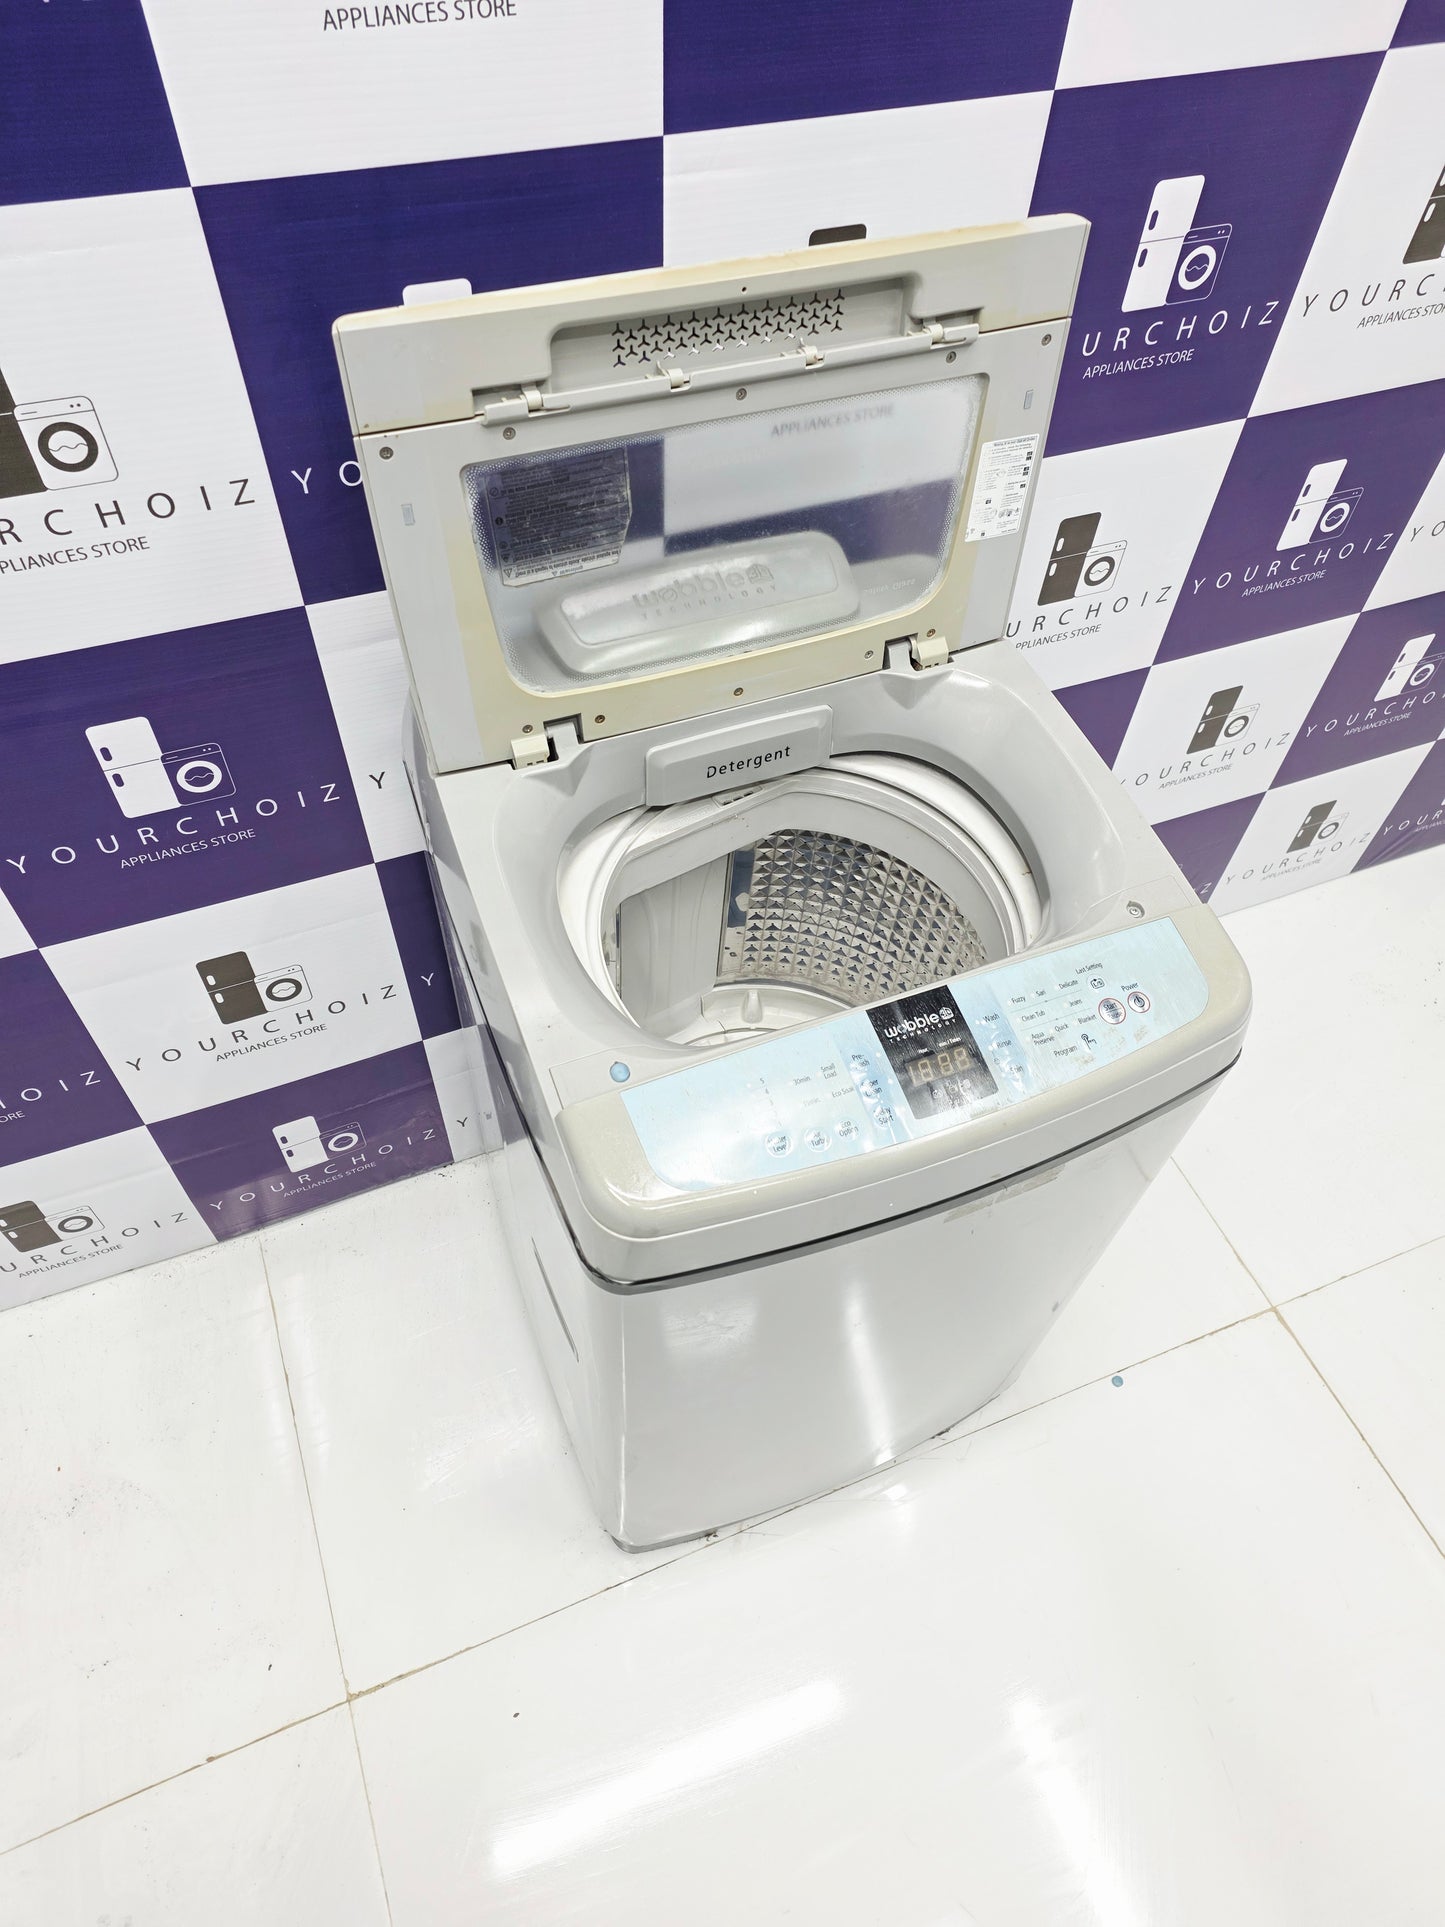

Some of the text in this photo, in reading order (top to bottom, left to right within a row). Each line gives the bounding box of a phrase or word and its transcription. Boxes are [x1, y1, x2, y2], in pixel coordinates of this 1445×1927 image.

[323, 0, 517, 31] APPLIANCES STORE
[1303, 273, 1445, 317] YOURC
[1357, 303, 1445, 328] APPLIANCES STO
[1082, 348, 1195, 380] APPLIANCES STORE
[91, 536, 150, 559] STORE
[1193, 533, 1394, 595] YOURCHOIZ
[1241, 569, 1327, 598] APPLIANCES STORE
[1070, 623, 1102, 639] STORE
[1306, 691, 1445, 738] YOURCHO
[706, 746, 791, 778] Detergent
[1158, 763, 1233, 790] APPLIANCES STORE
[6, 783, 340, 875] YOURCHOIZ
[120, 828, 256, 869] APPLIANCES STORE
[1225, 832, 1370, 885] YOURCHOIZ
[1121, 982, 1139, 992] Power
[126, 984, 397, 1072] YOURCHOIZ
[215, 1023, 328, 1063] APPLIANCES STORE
[884, 1012, 940, 1039] wobble
[209, 1128, 436, 1211] YOURCHOIZ
[283, 1161, 377, 1198] APPLIANCES STORE
[18, 1243, 124, 1279] APPLIANCES STORE
